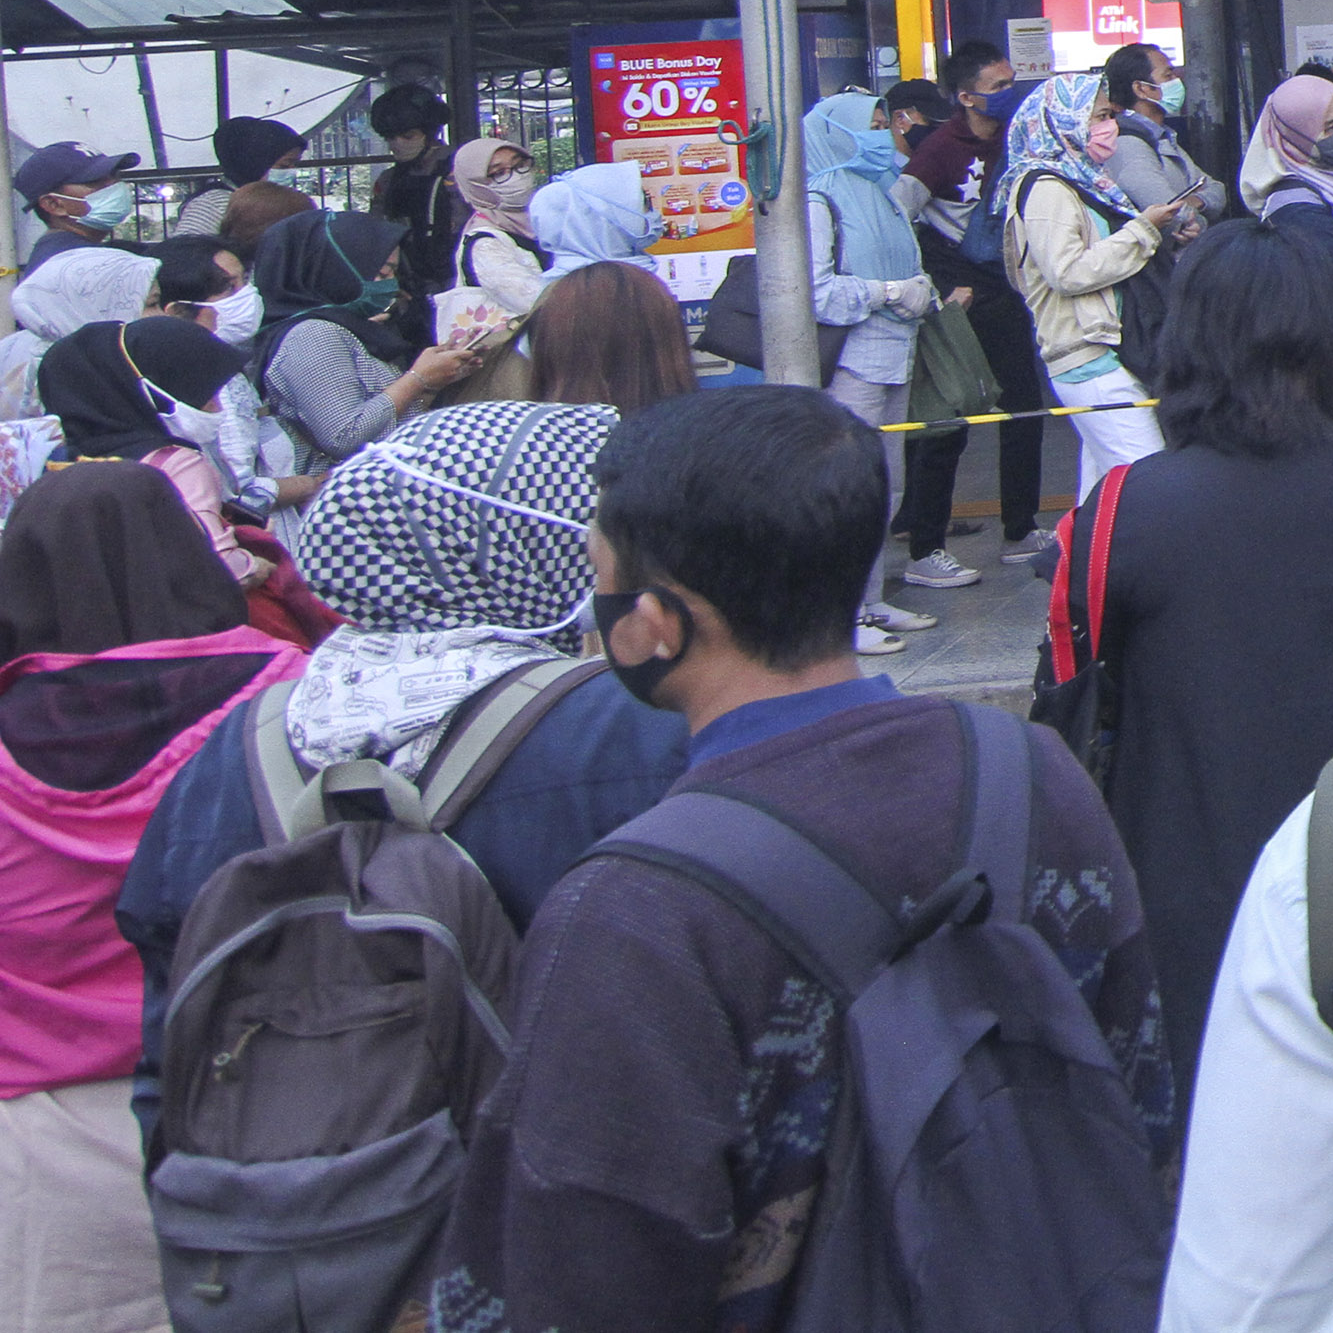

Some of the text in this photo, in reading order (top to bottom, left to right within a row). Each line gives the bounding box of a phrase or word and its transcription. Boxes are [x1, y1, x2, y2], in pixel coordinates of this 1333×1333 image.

[1100, 5, 1124, 16] ATM
[1099, 15, 1139, 34] Link
[620, 59, 655, 71] BLUE
[657, 57, 694, 69] Bonus
[696, 55, 723, 69] Day
[623, 80, 718, 118] 60%
